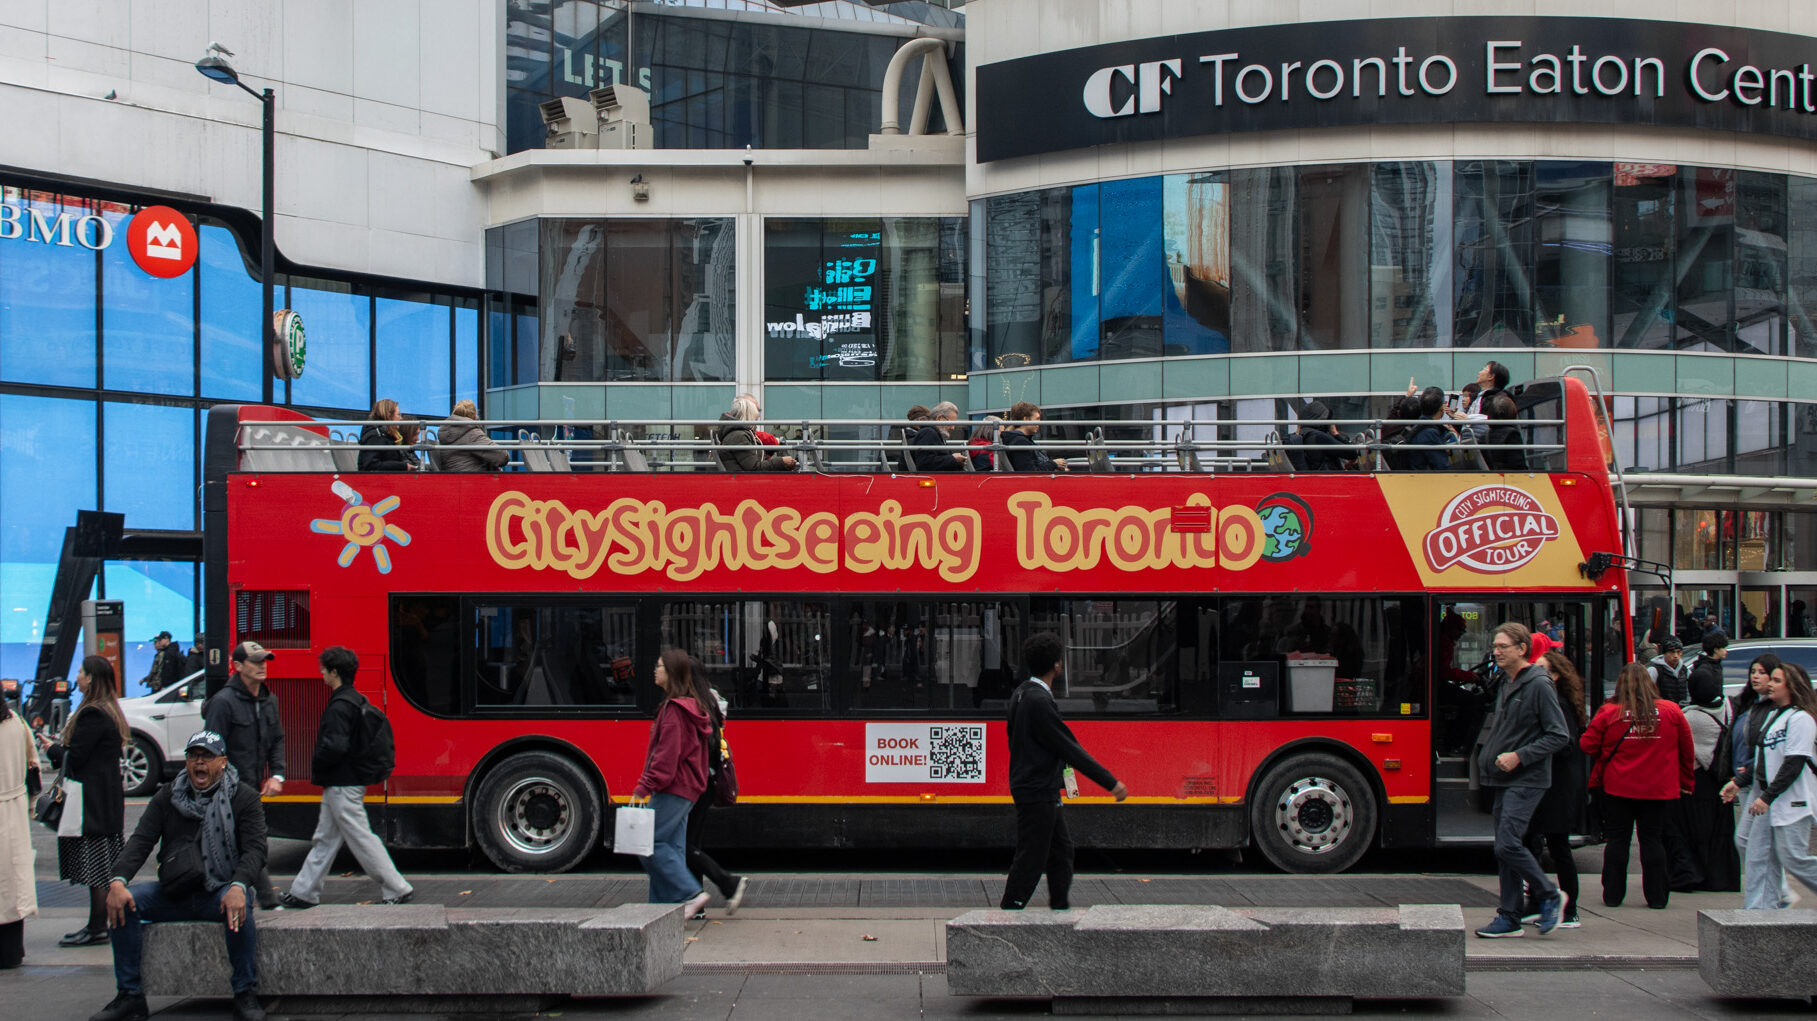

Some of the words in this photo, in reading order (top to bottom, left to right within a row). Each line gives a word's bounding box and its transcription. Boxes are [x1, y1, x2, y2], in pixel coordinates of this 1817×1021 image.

[1083, 58, 1182, 118] CF
[1200, 47, 1458, 106] Toronto
[1487, 41, 1664, 97] Eaton
[1690, 47, 1816, 112] Cent
[0, 204, 113, 250] BMO
[1455, 499, 1474, 518] CITY
[1473, 490, 1532, 510] SIGHTSEEING
[1438, 515, 1554, 557] OFFICIAL
[1485, 541, 1533, 565] TOUR
[877, 738, 919, 749] BOOK
[869, 755, 927, 766] ONLINE!
